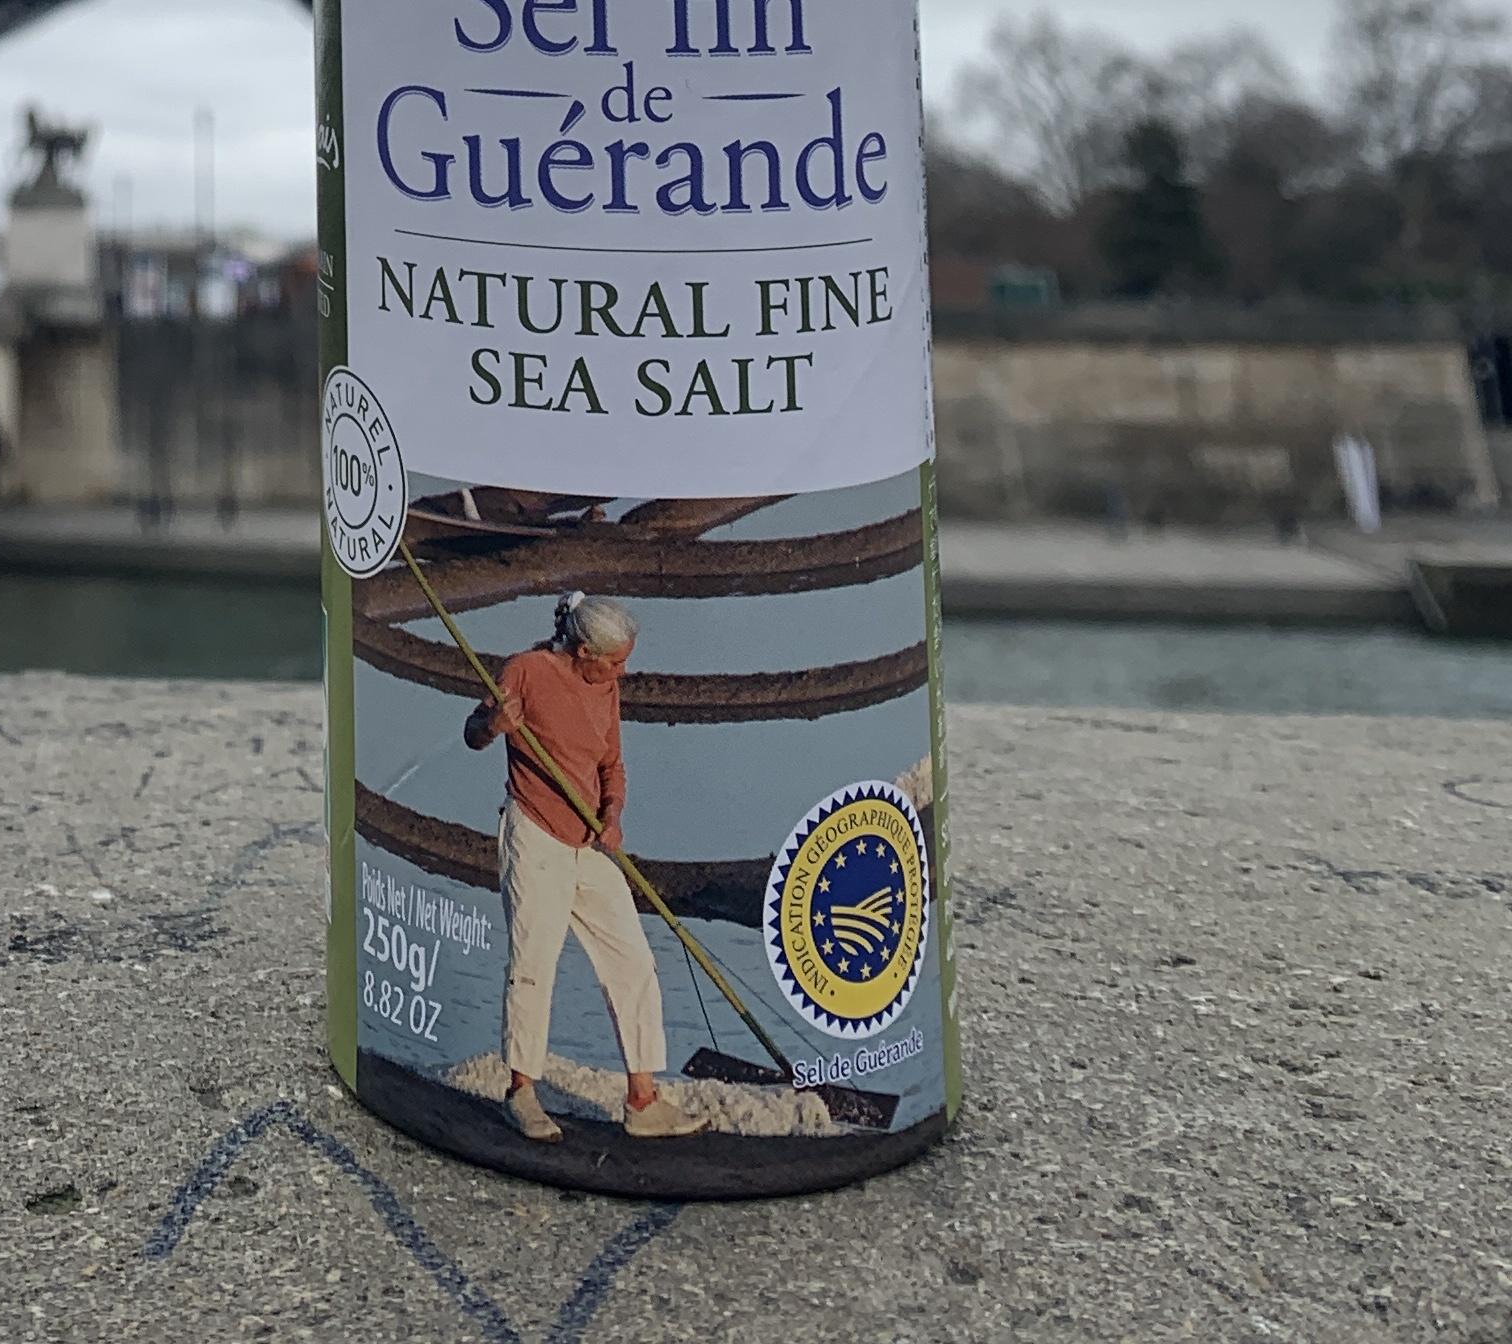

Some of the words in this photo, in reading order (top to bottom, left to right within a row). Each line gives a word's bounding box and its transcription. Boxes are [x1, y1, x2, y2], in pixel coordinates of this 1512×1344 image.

[601, 60, 673, 124] de
[376, 84, 888, 216] Guérande
[376, 255, 731, 338] NATURAL
[754, 266, 893, 337] FINE
[469, 348, 609, 415] SEA
[634, 351, 814, 417] SALT
[325, 382, 391, 466] NATUREL
[333, 444, 375, 497] 100%
[326, 487, 395, 562] NATURAL
[806, 808, 912, 865] GÉOGRAPHIQUE
[362, 861, 386, 912] Poids
[387, 874, 406, 922] Net
[407, 885, 415, 927] /
[415, 888, 438, 934] Net
[439, 896, 492, 956] Weight:
[788, 867, 829, 995] INDICATION
[363, 970, 404, 1026] 8.82
[409, 994, 443, 1043] OZ
[794, 1057, 824, 1087] Sel
[830, 1055, 851, 1080] de
[855, 1028, 923, 1074] Guérande
